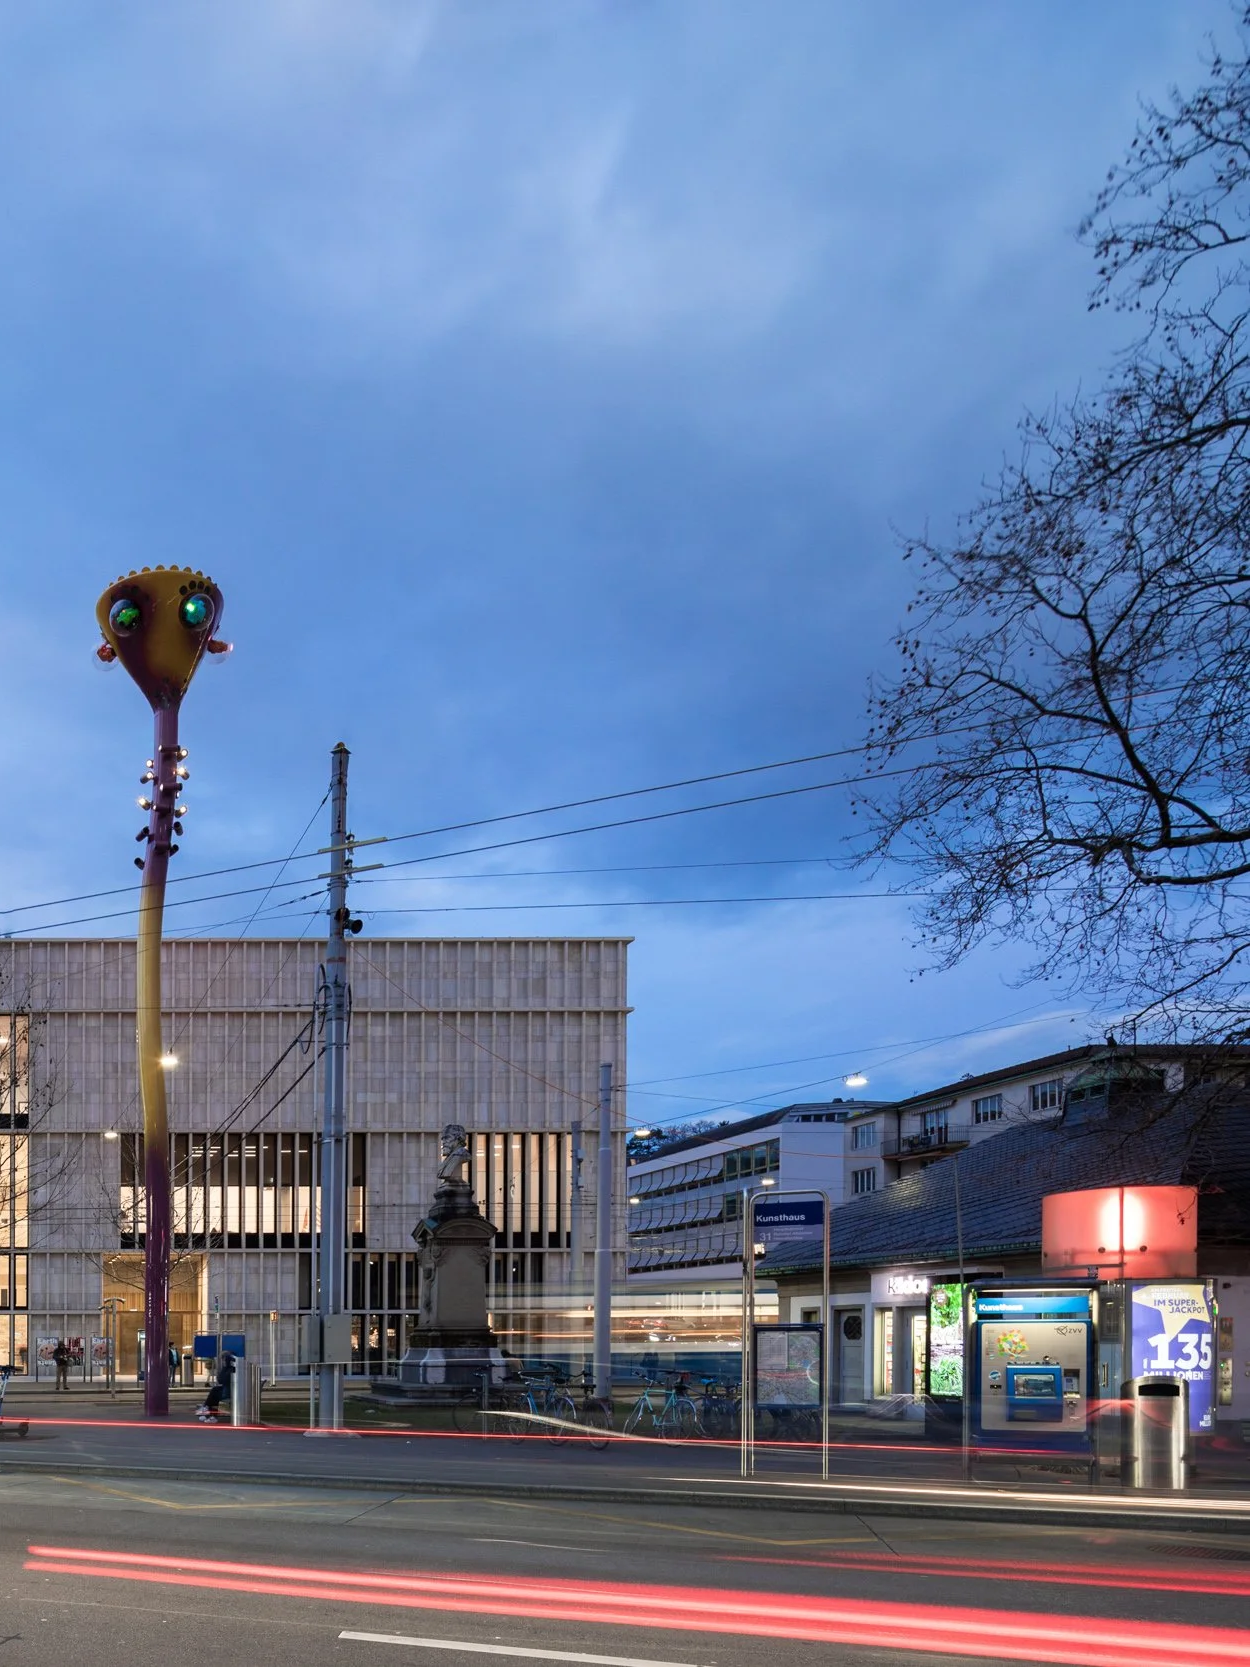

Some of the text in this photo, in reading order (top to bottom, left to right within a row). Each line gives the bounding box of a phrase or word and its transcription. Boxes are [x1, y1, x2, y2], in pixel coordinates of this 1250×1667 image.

[756, 1213, 806, 1223] Kunsthaus
[759, 1232, 772, 1241] 31
[1153, 1299, 1199, 1307] IM SUPER-
[1169, 1306, 1206, 1314] JACKPOT
[1147, 1333, 1212, 1370] 135
